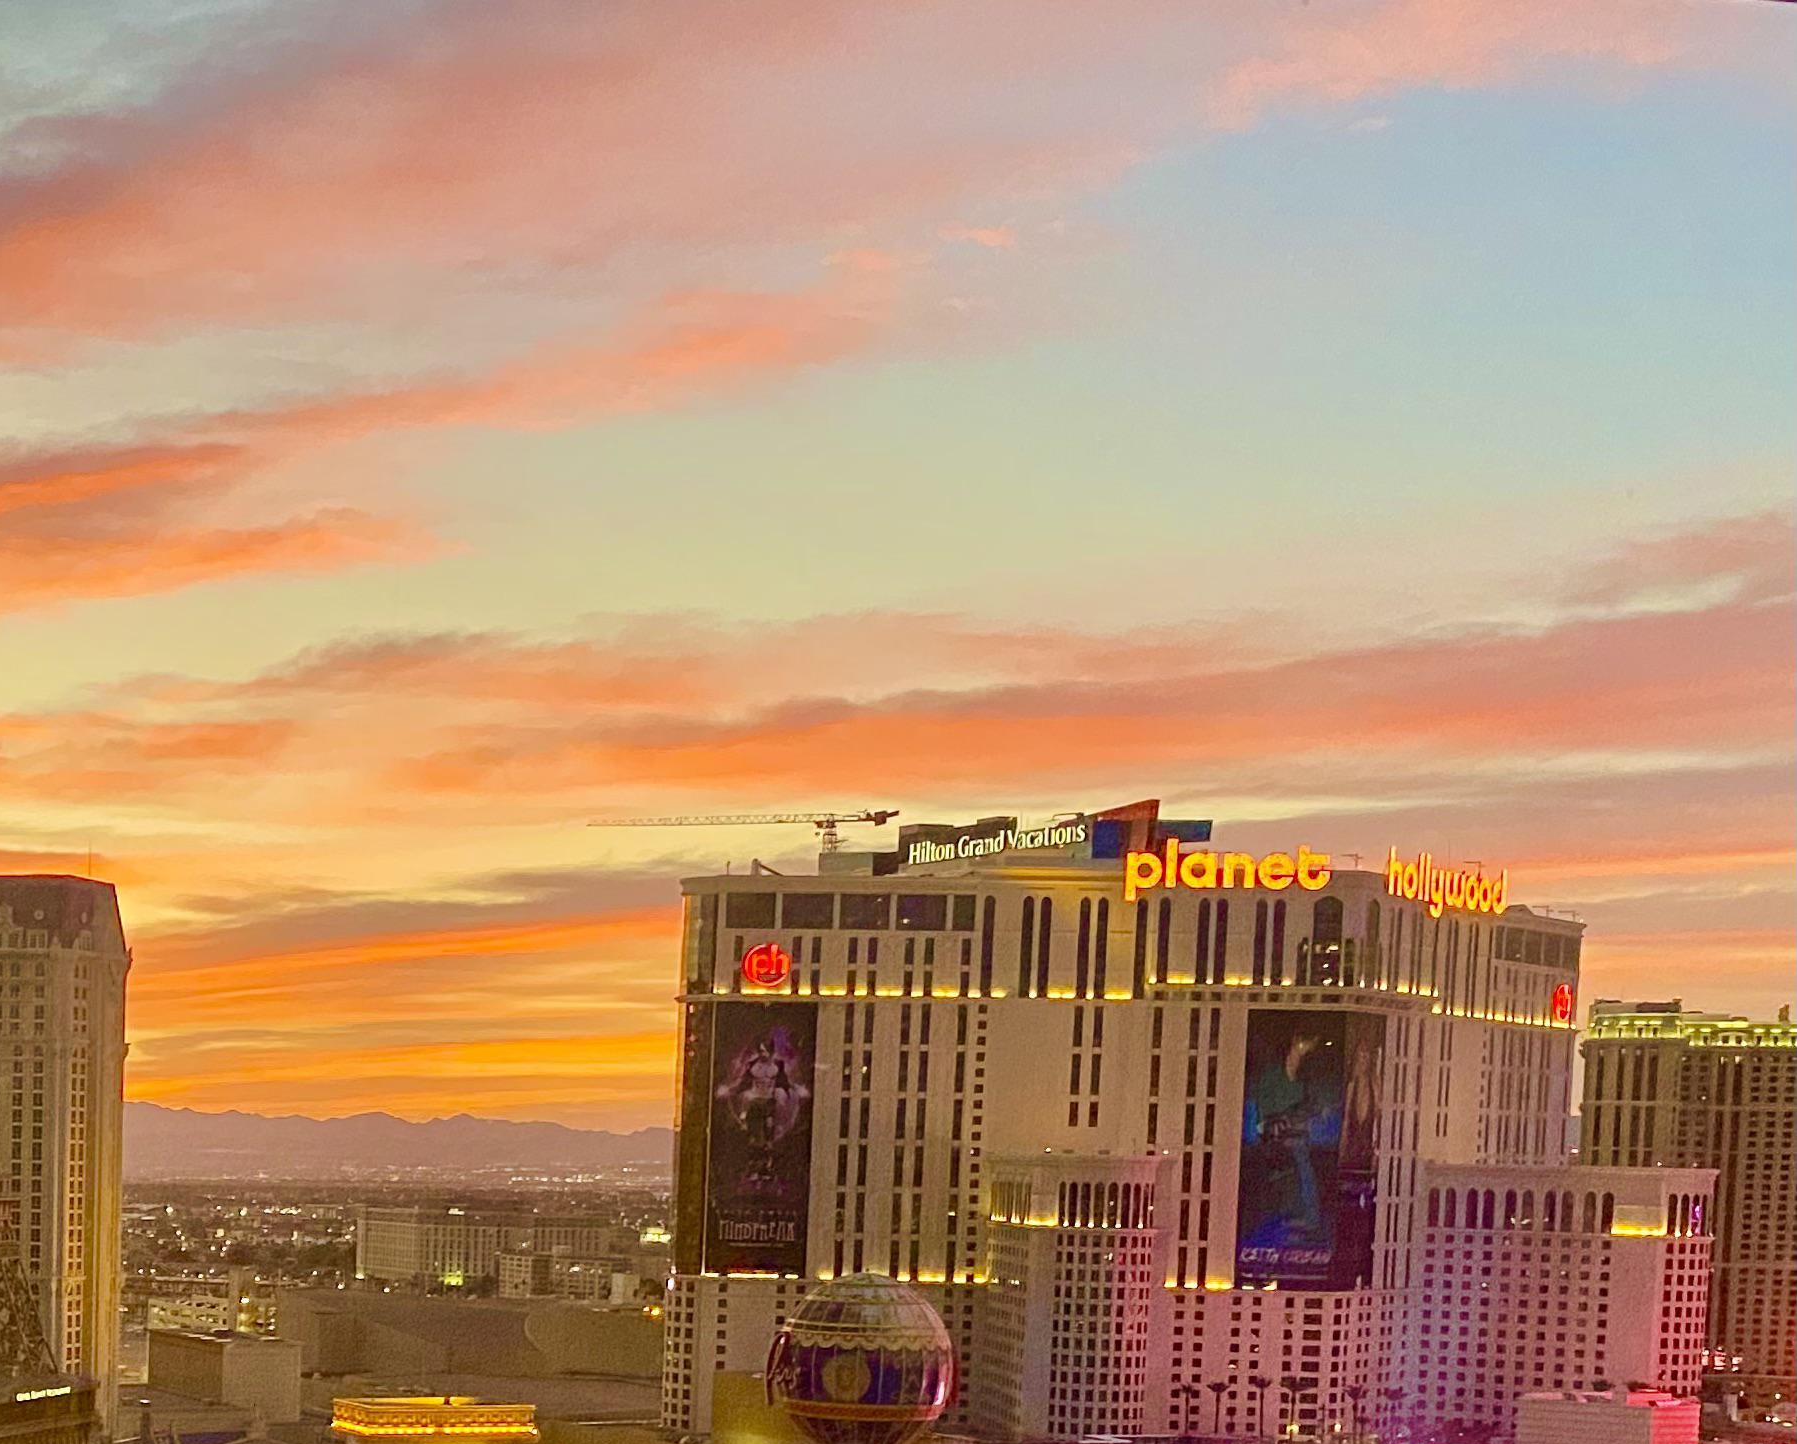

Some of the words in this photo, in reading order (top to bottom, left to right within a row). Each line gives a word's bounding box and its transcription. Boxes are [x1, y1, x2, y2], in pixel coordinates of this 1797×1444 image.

[908, 840, 955, 865] Hilton
[957, 829, 1006, 859] Grand
[1007, 824, 1087, 851] Vacations
[1125, 838, 1331, 901] planet
[1387, 845, 1508, 918] hollywood
